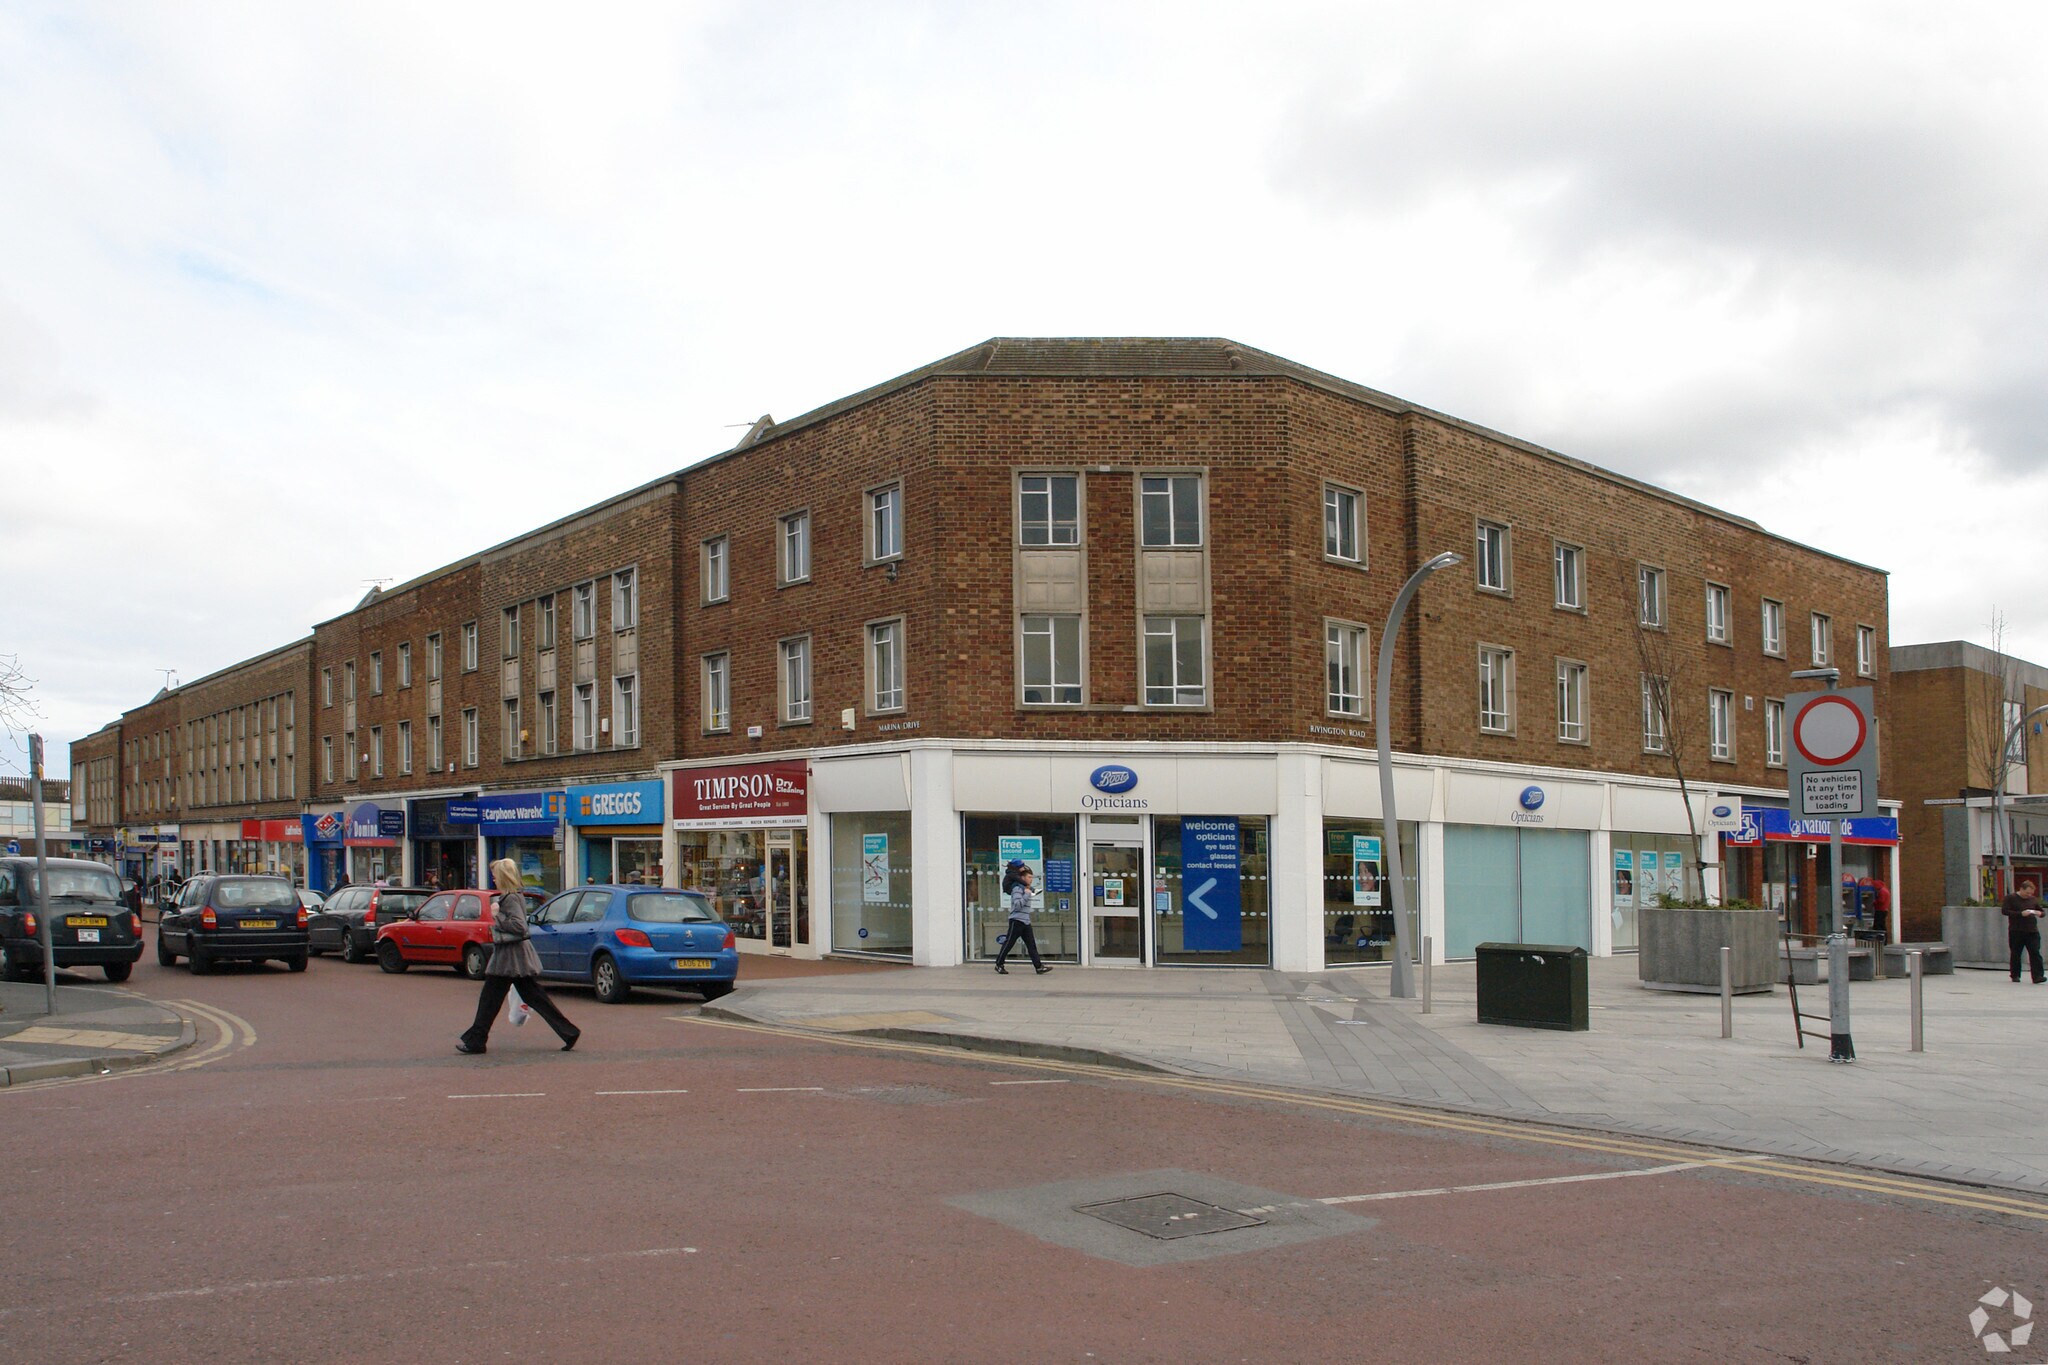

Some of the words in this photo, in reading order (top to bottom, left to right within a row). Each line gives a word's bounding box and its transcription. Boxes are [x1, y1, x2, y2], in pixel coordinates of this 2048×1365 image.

[878, 723, 900, 732] MARINA
[903, 721, 920, 730] DRIVE
[1310, 724, 1346, 736] RIVINGTON
[1349, 729, 1366, 738] ROAD
[776, 778, 793, 789] Dry
[1097, 771, 1129, 787] Boots
[1806, 776, 1819, 784] No
[1821, 774, 1857, 783] vehicles
[694, 773, 774, 801] TIMPSON
[776, 786, 805, 796] Cleaning
[1809, 793, 1838, 801] except
[592, 791, 642, 816] GREGGS
[699, 803, 711, 811] Great
[712, 802, 730, 810] Service
[731, 802, 738, 810] By
[739, 801, 752, 809] Great
[753, 801, 771, 809] People
[1081, 795, 1148, 811] Opticians
[1815, 802, 1848, 810] loading
[485, 807, 516, 821] Carphone
[516, 806, 543, 819] Wareho
[1511, 810, 1544, 824] Opticians
[1185, 821, 1236, 831] welcome
[1801, 819, 1853, 836] Natiode
[1196, 832, 1236, 842] opticians
[1331, 833, 1345, 841] free
[1001, 840, 1023, 849] free
[1356, 839, 1370, 849] free
